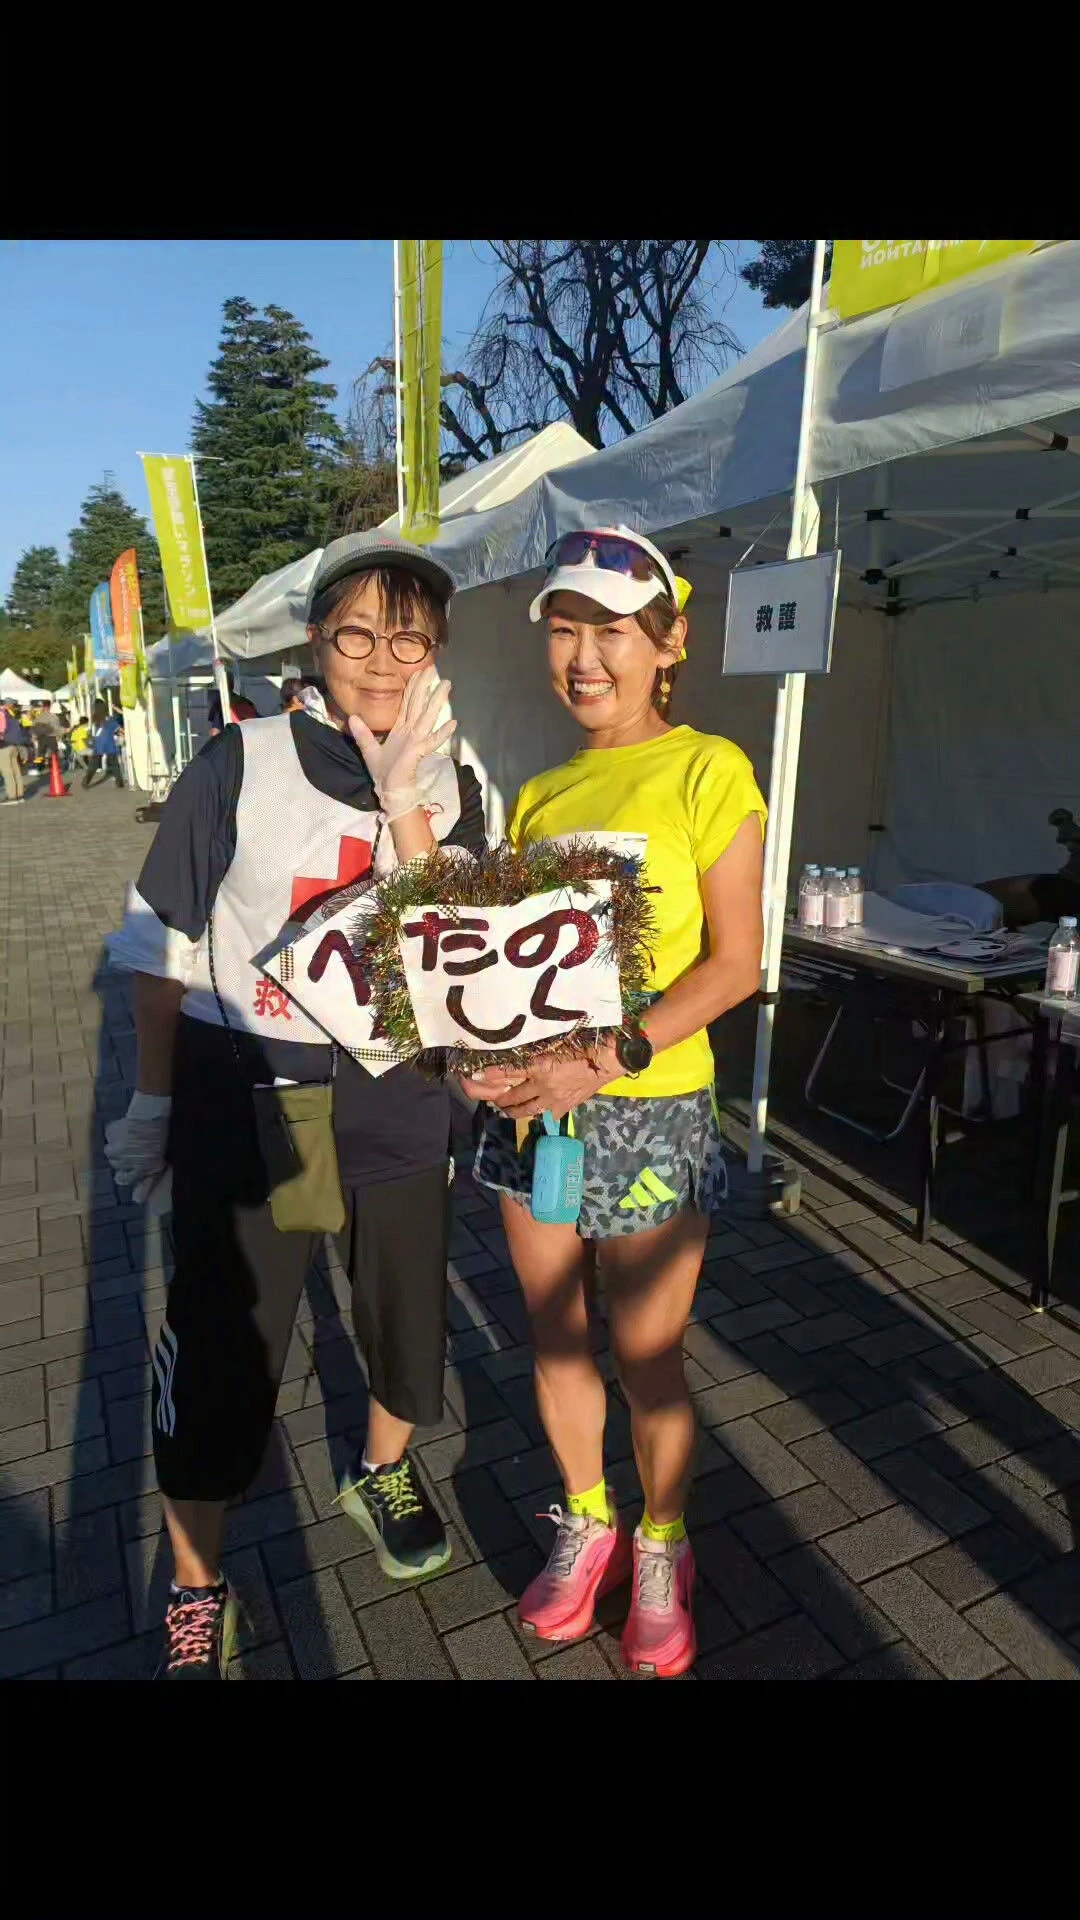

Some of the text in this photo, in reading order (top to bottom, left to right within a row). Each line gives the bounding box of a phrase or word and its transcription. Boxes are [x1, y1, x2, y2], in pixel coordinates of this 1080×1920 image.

[755, 601, 797, 633] 救護
[403, 908, 600, 976] たの
[445, 964, 590, 1045] しく
